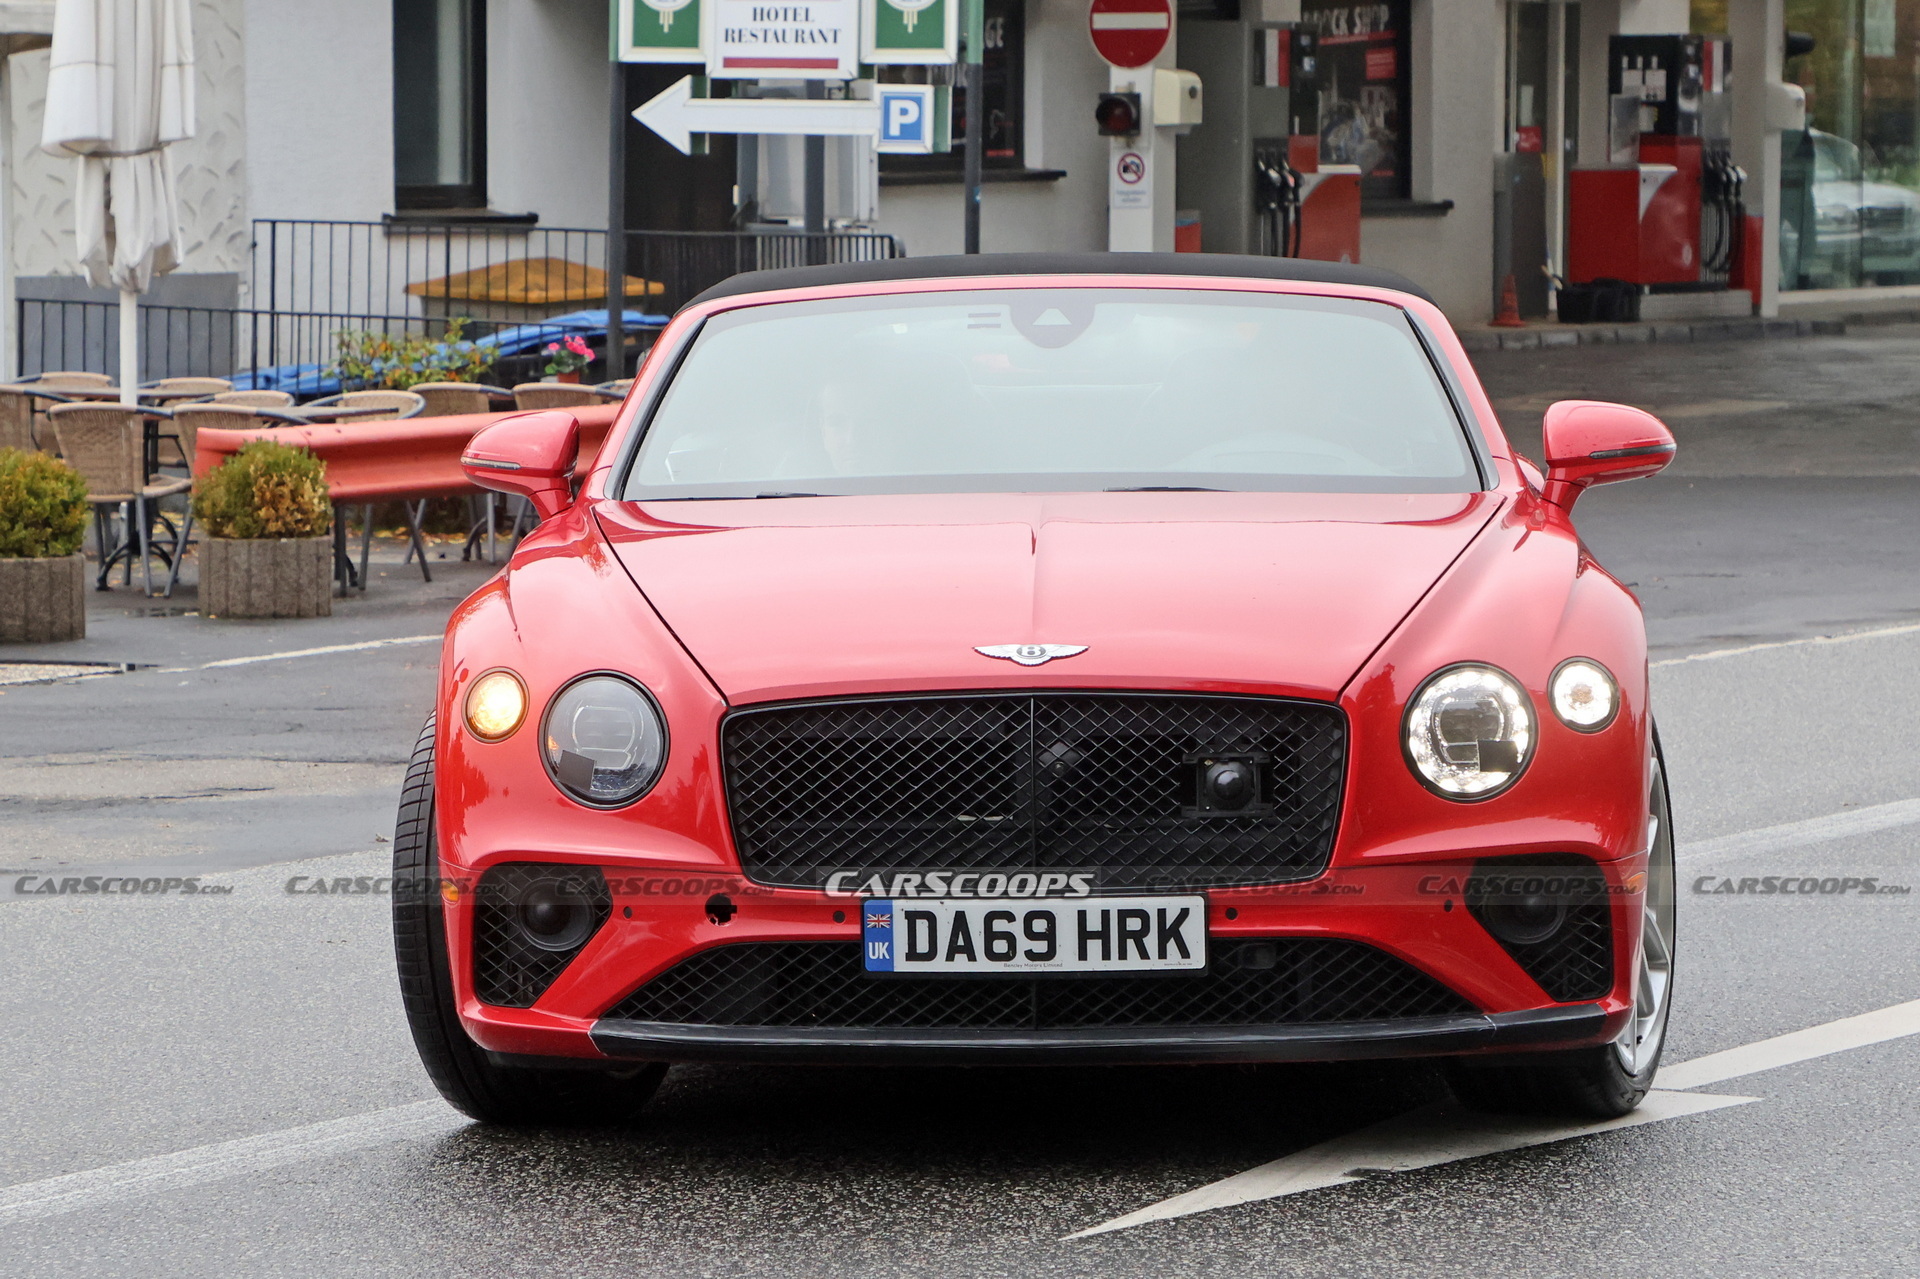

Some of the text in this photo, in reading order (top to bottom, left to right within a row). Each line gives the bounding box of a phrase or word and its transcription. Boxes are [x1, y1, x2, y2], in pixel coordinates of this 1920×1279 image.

[752, 7, 815, 22] HOTEL
[724, 28, 841, 43] RESTAURANT
[889, 99, 920, 136] P
[904, 907, 1191, 963] DA69 HRK
[868, 941, 891, 960] UK
